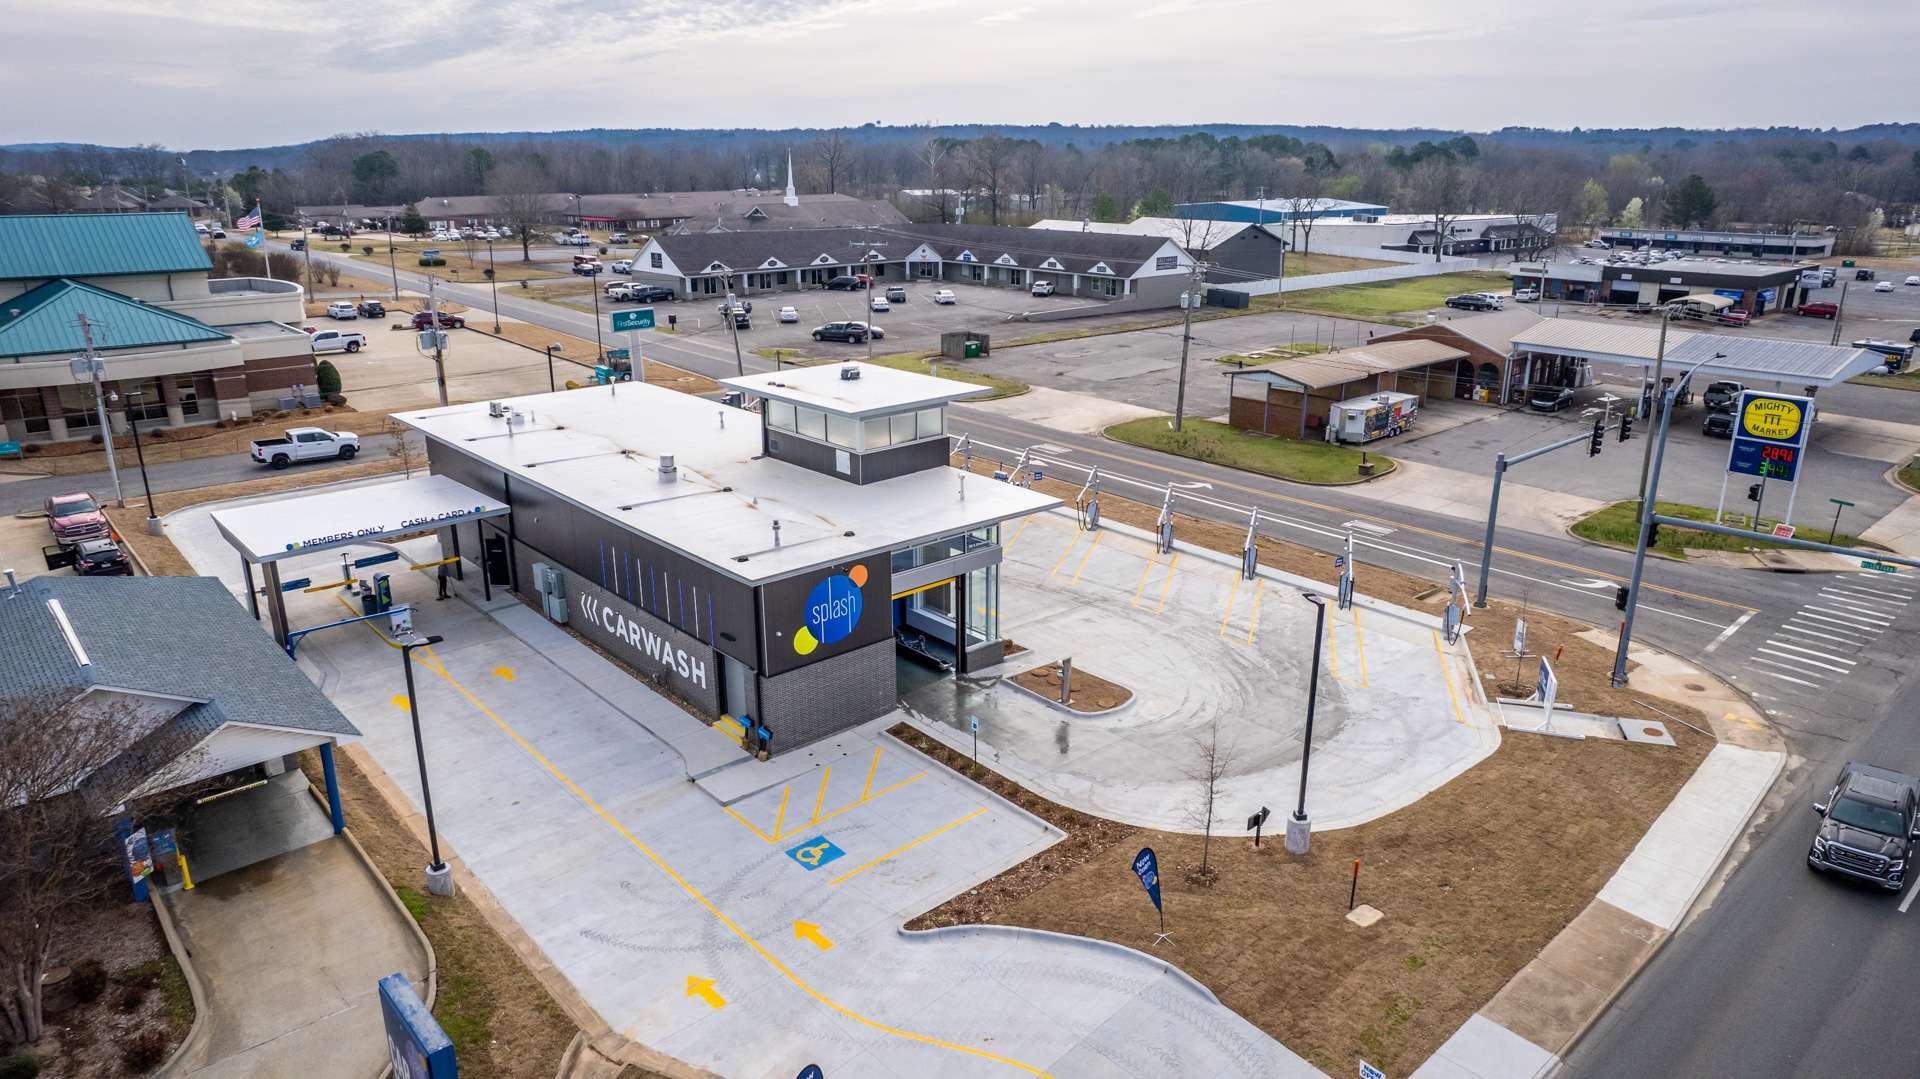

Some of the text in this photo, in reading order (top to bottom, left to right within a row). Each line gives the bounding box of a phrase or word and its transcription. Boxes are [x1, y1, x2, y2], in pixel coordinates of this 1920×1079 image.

[1754, 402, 1794, 414] MIGHTY
[1752, 424, 1789, 435] MARKET
[401, 516, 427, 528] CASH
[439, 509, 464, 521] CARD
[302, 525, 384, 548] MEMBERS ONLY
[812, 577, 856, 643] splash
[602, 607, 706, 689] CARWASH
